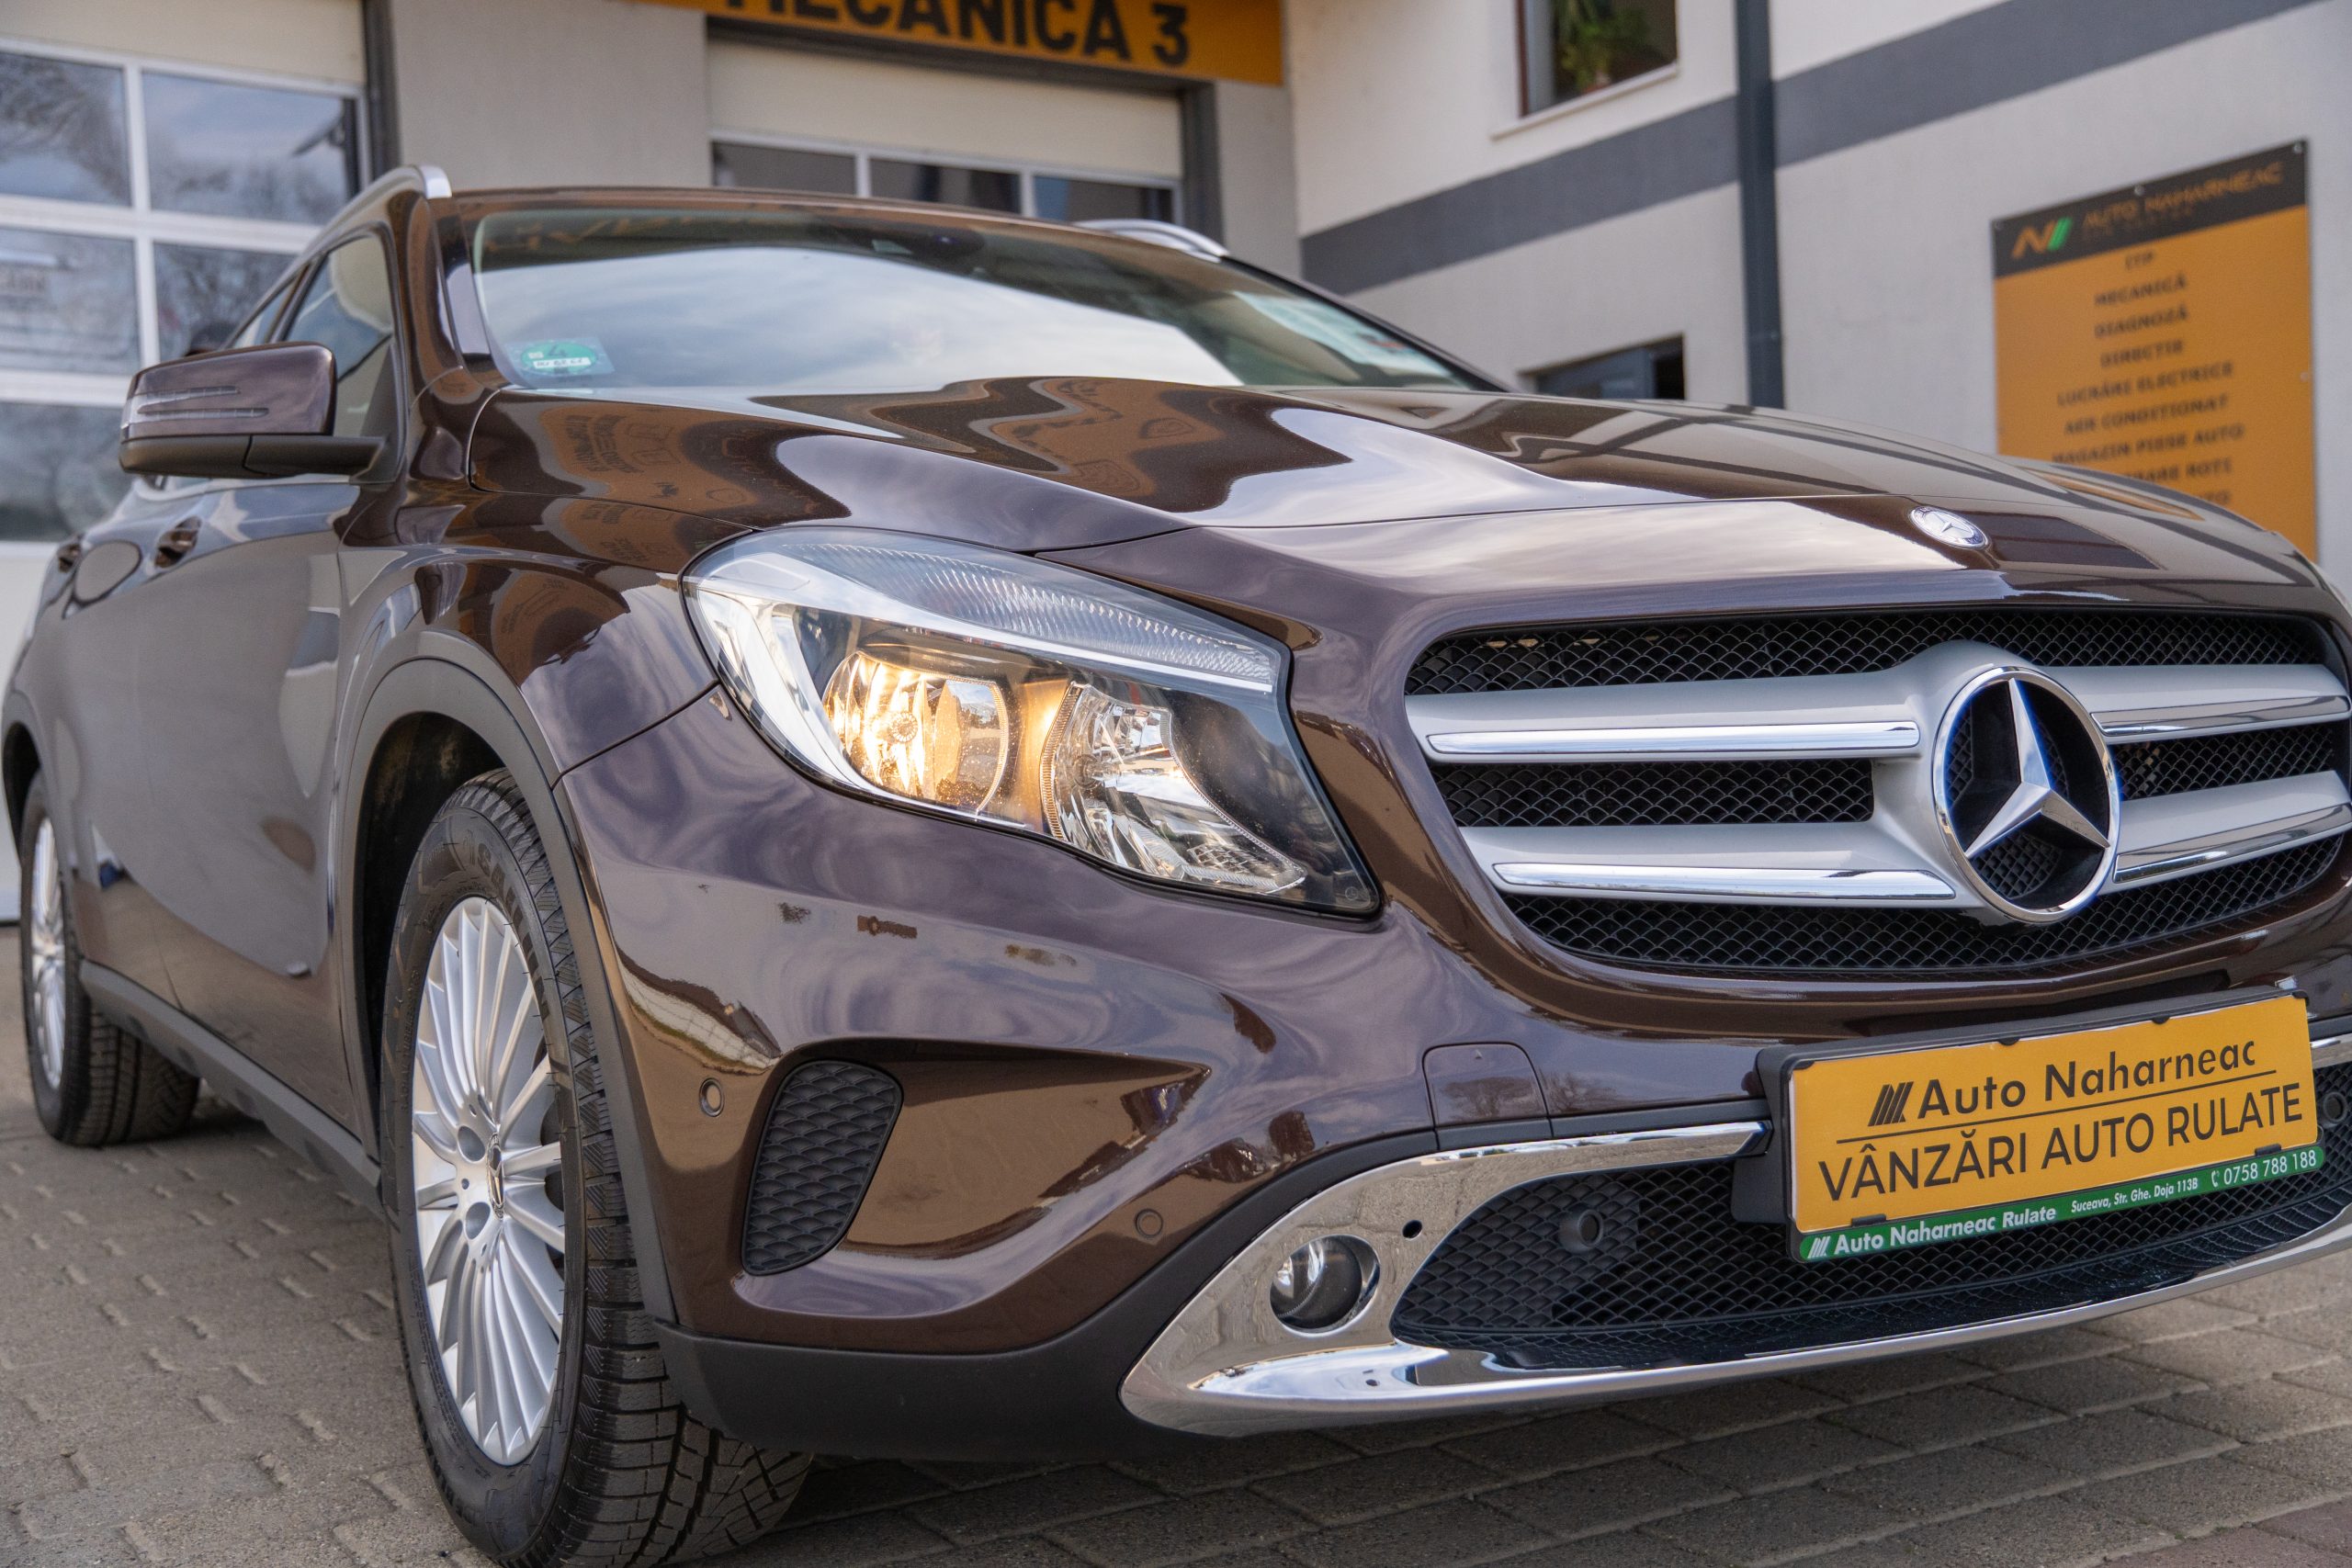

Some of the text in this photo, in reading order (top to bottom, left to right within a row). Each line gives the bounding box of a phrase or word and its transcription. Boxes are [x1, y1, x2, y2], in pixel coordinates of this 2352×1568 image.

[729, 0, 1190, 66] ANICA 3
[2195, 423, 2245, 445] AUTO
[1917, 1040, 2256, 1120] Auto Naharneac
[1817, 1082, 2303, 1201] VÂNZĂRI AUTO RULATE
[2223, 1149, 2317, 1186] 0758 788 188
[2071, 1177, 2199, 1213] Suceava, Str. Ghe. Doja 113B
[1834, 1205, 2057, 1256] Auto Naharneac Rulate
